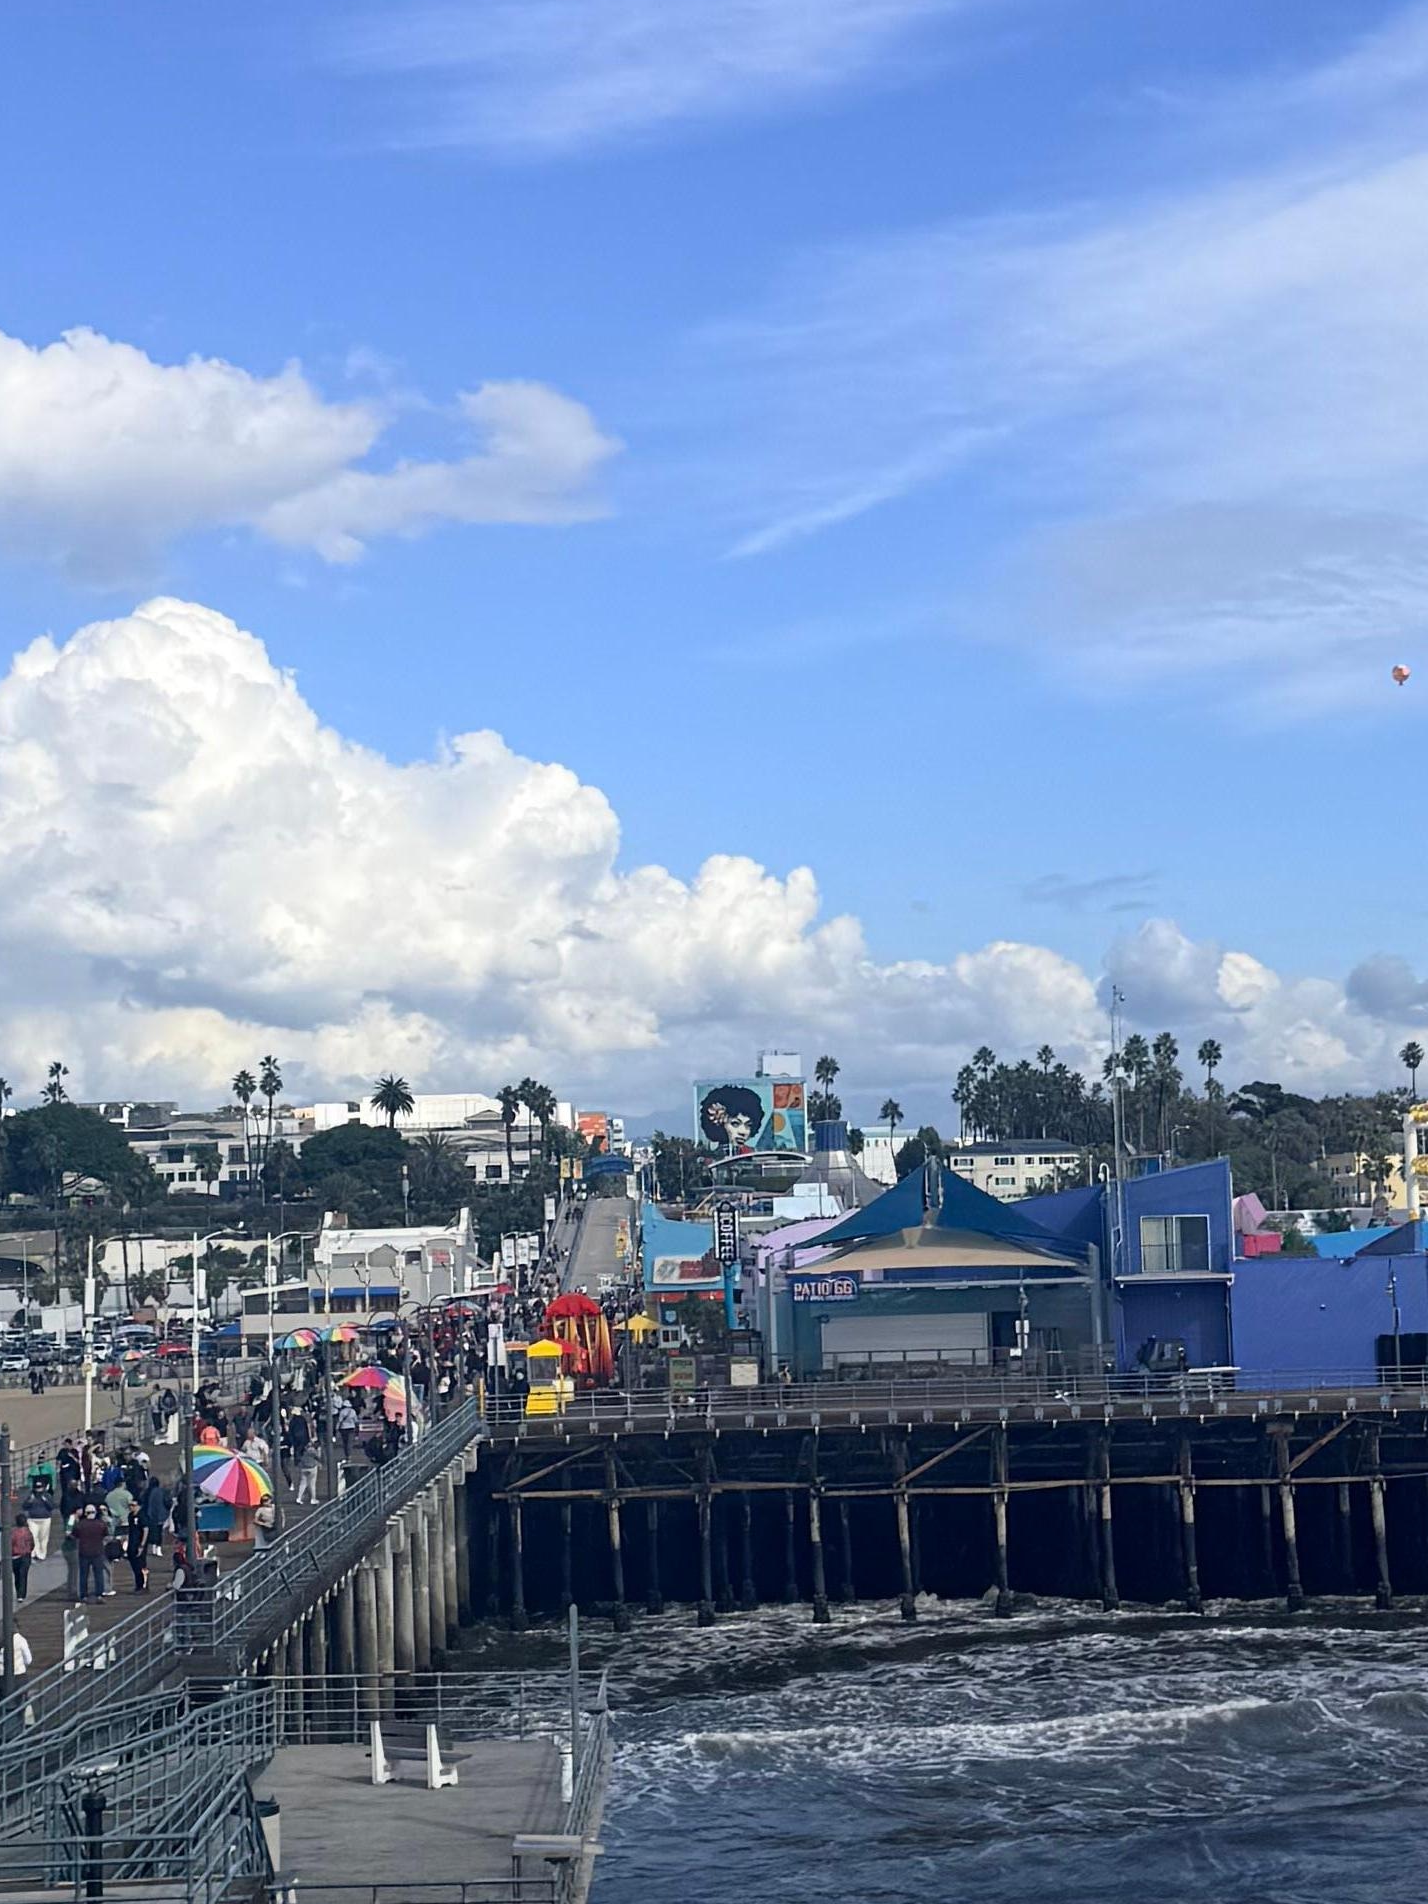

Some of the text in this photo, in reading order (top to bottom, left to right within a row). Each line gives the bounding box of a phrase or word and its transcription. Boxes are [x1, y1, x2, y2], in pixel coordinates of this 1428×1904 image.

[720, 1217, 734, 1260] COFFEE
[794, 1280, 853, 1296] PATIO 66
